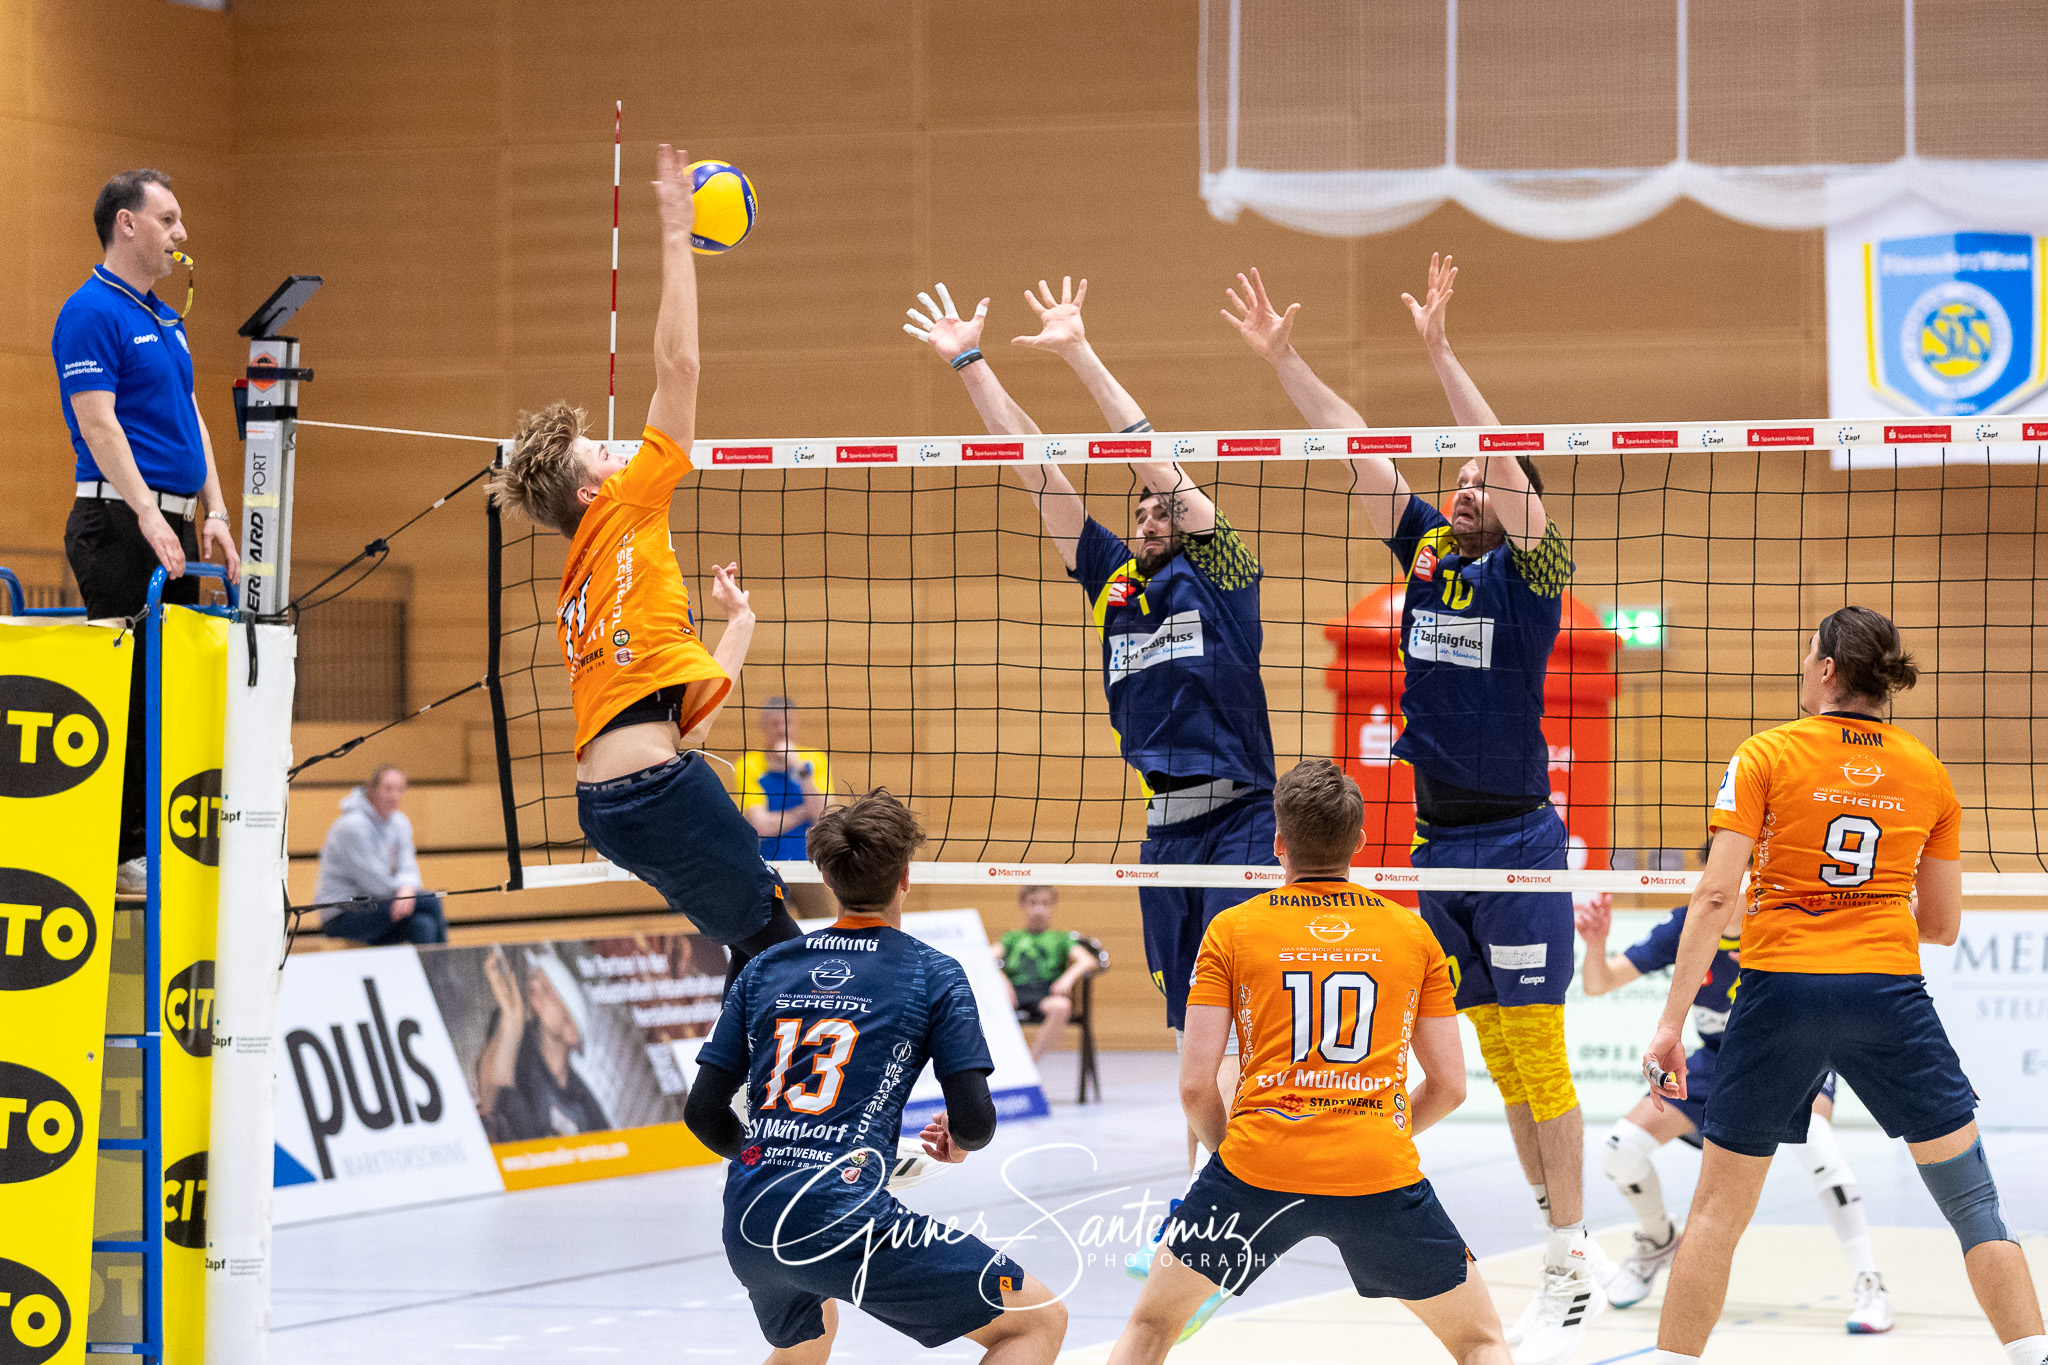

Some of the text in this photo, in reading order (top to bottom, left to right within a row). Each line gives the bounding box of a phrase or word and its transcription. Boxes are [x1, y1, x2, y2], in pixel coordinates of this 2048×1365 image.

[1844, 434, 1861, 442] Zapf
[1982, 431, 1999, 439] Zapf
[1441, 442, 1457, 450] Zapf
[1573, 439, 1590, 447] Zapf
[1101, 447, 1124, 455] Sparkasse
[1842, 728, 1883, 747] KAHN
[1829, 789, 1870, 797] FREUNDLICHE
[1871, 793, 1905, 802] AUTOHAUS
[1813, 792, 1906, 812] SCHEIDL
[1818, 813, 1883, 887] 9
[1516, 875, 1552, 883] Marmot
[1650, 877, 1686, 885] Marmot
[1269, 892, 1385, 907] BRANDSTETTER
[1278, 952, 1383, 962] SCHEIDL
[835, 995, 873, 1003] AUTOHAUS
[775, 999, 872, 1013] SCHEIDL
[1282, 971, 1378, 1065] 10
[760, 1018, 860, 1115] 13
[285, 978, 443, 1180] puls
[1294, 1069, 1392, 1092] Mühldorf
[1309, 1097, 1383, 1109] STADTWERKE
